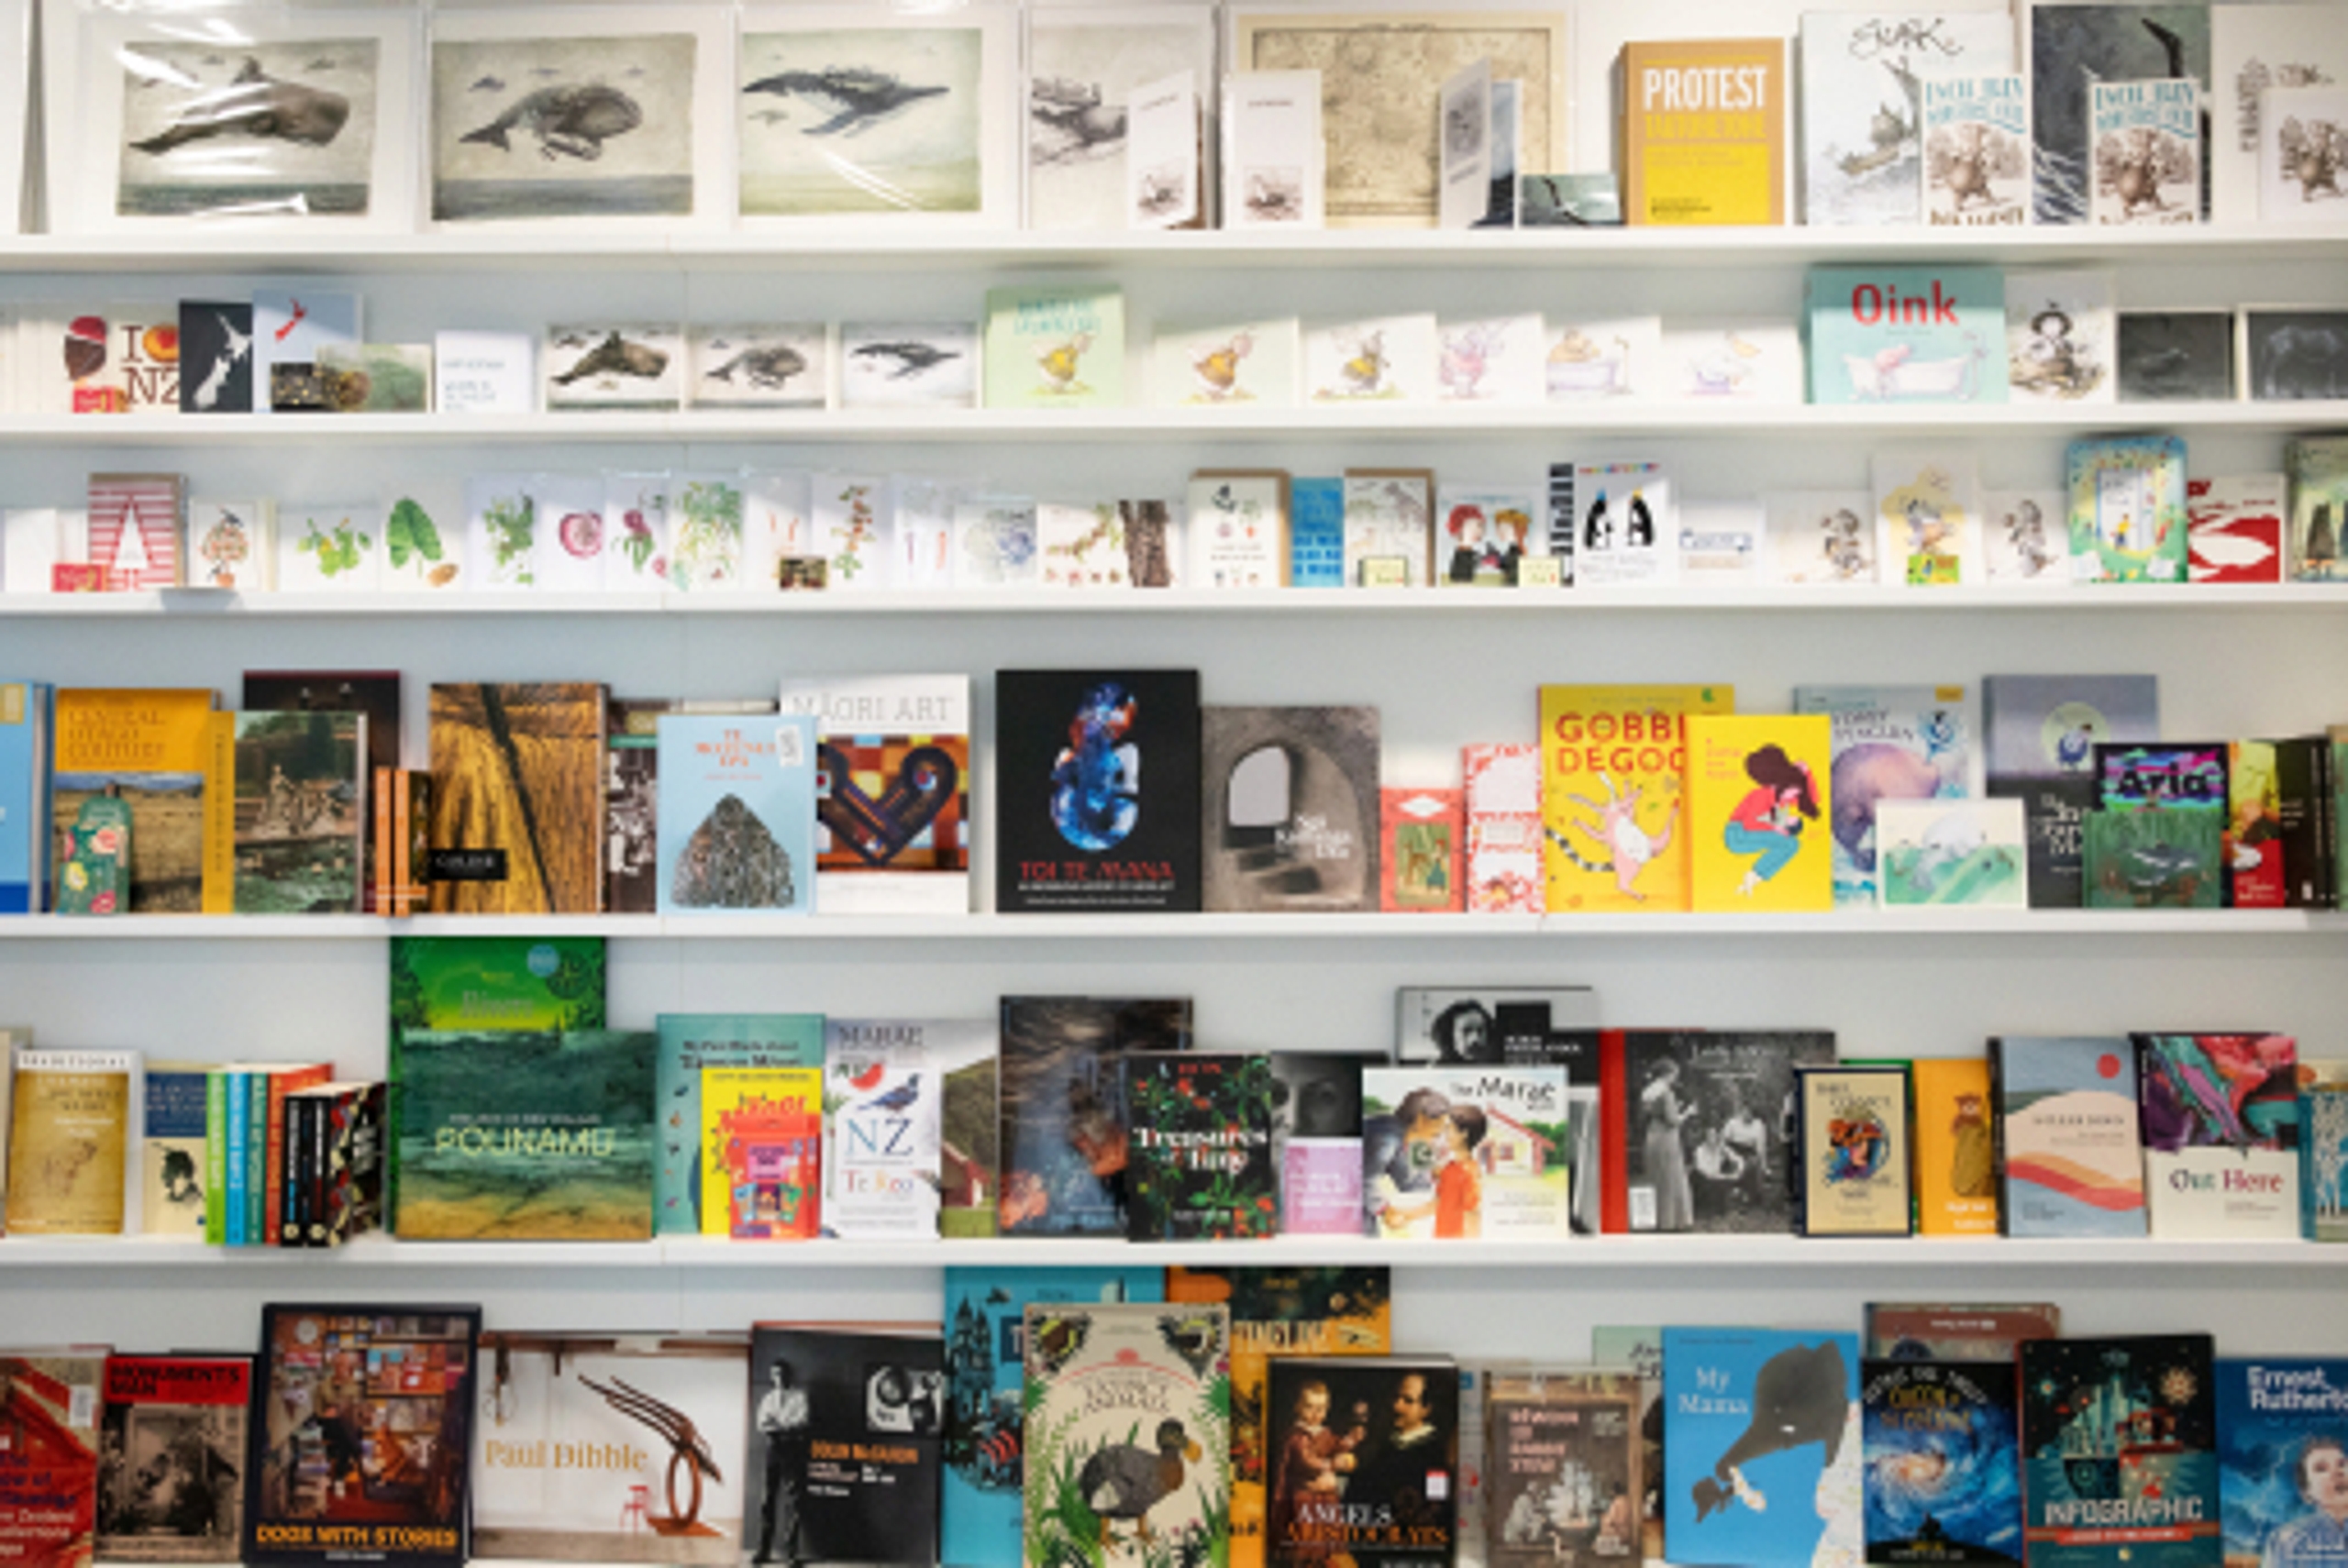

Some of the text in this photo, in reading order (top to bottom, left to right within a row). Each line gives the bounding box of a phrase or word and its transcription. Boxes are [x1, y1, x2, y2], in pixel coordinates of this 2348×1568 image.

[1643, 65, 1767, 112] PROTEST
[1852, 279, 1959, 326] Oink
[120, 326, 143, 363] I
[120, 367, 179, 404] NZ
[893, 695, 954, 721] ART
[1477, 1076, 1556, 1100] Marae
[435, 1126, 616, 1157] POUNAMU
[844, 1117, 914, 1157] NZ
[840, 1169, 869, 1193] Te
[2168, 1167, 2285, 1193] Out Here
[1696, 1365, 1731, 1395] My
[2247, 1365, 2326, 1387] Ernest
[1678, 1394, 1749, 1414] Mama
[485, 1439, 649, 1473] Paul Dibble
[1297, 1503, 1395, 1527] ANGELS
[2044, 1498, 2204, 1526] INFOGRAPHIC
